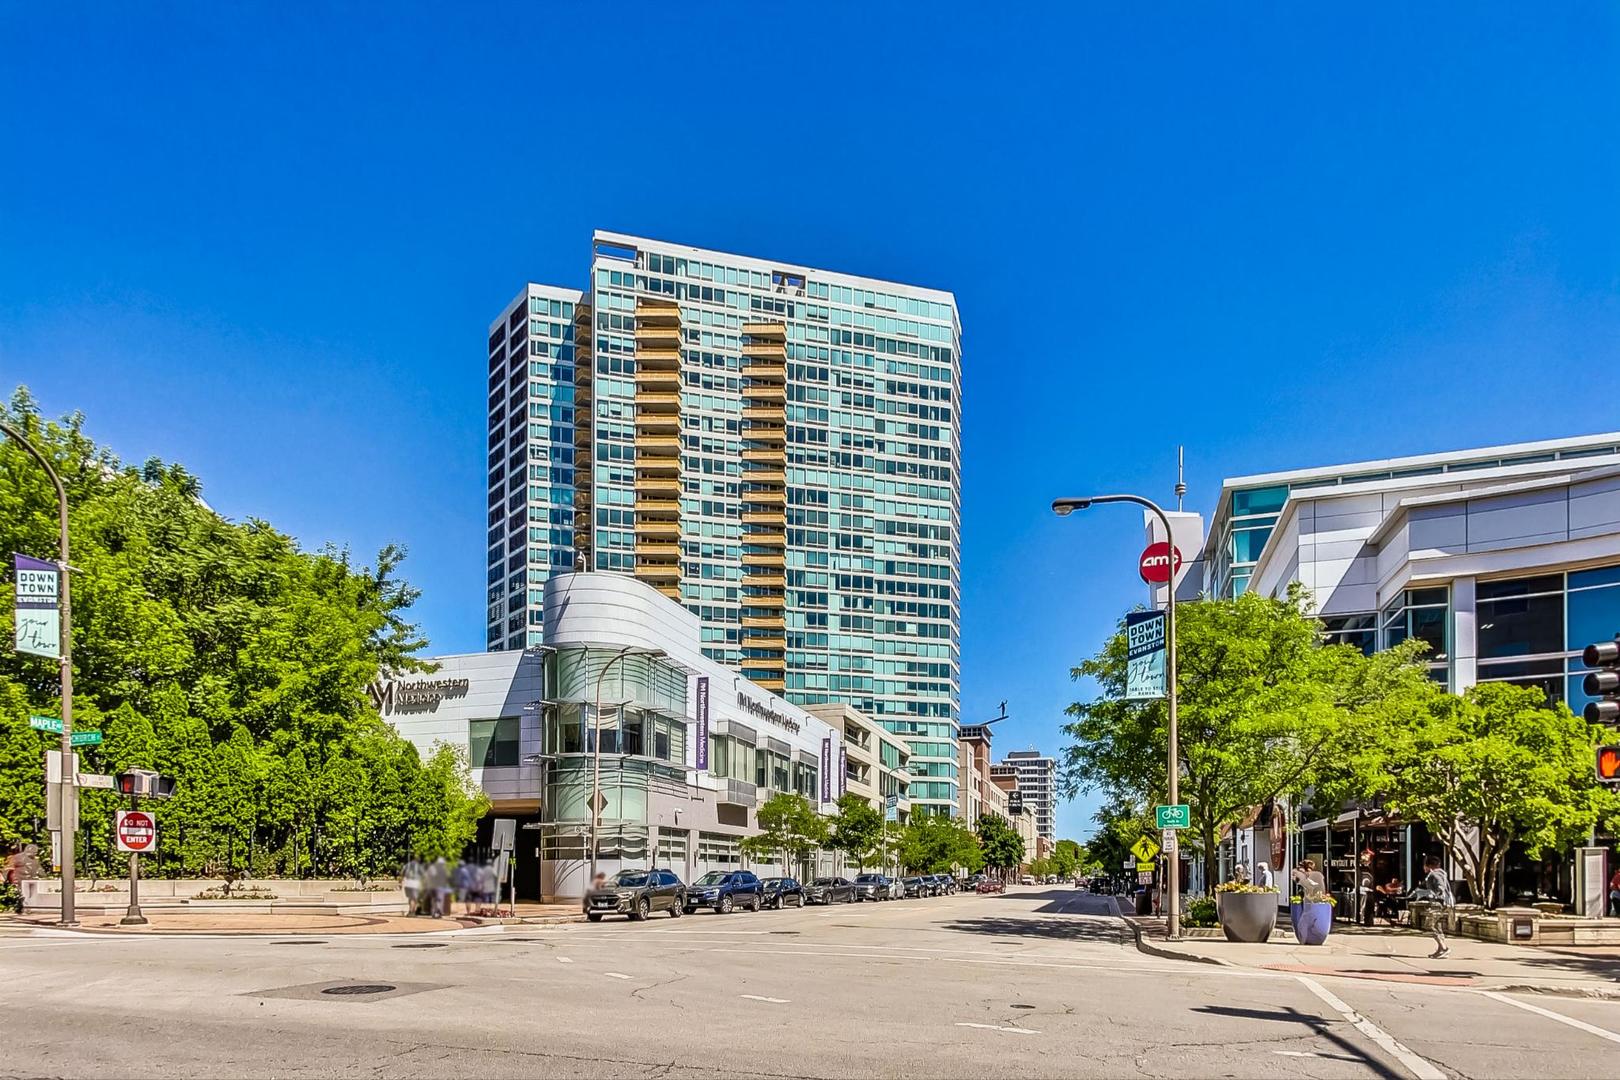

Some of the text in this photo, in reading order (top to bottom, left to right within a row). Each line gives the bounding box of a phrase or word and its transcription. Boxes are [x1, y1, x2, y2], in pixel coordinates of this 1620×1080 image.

[20, 573, 55, 583] DOWN
[20, 584, 55, 593] TOWN
[1130, 618, 1163, 637] DOWN
[1131, 628, 1163, 646] TOWN
[1129, 640, 1165, 656] EVANSTON
[397, 678, 469, 692] Northwestern
[31, 716, 57, 731] MAPLE
